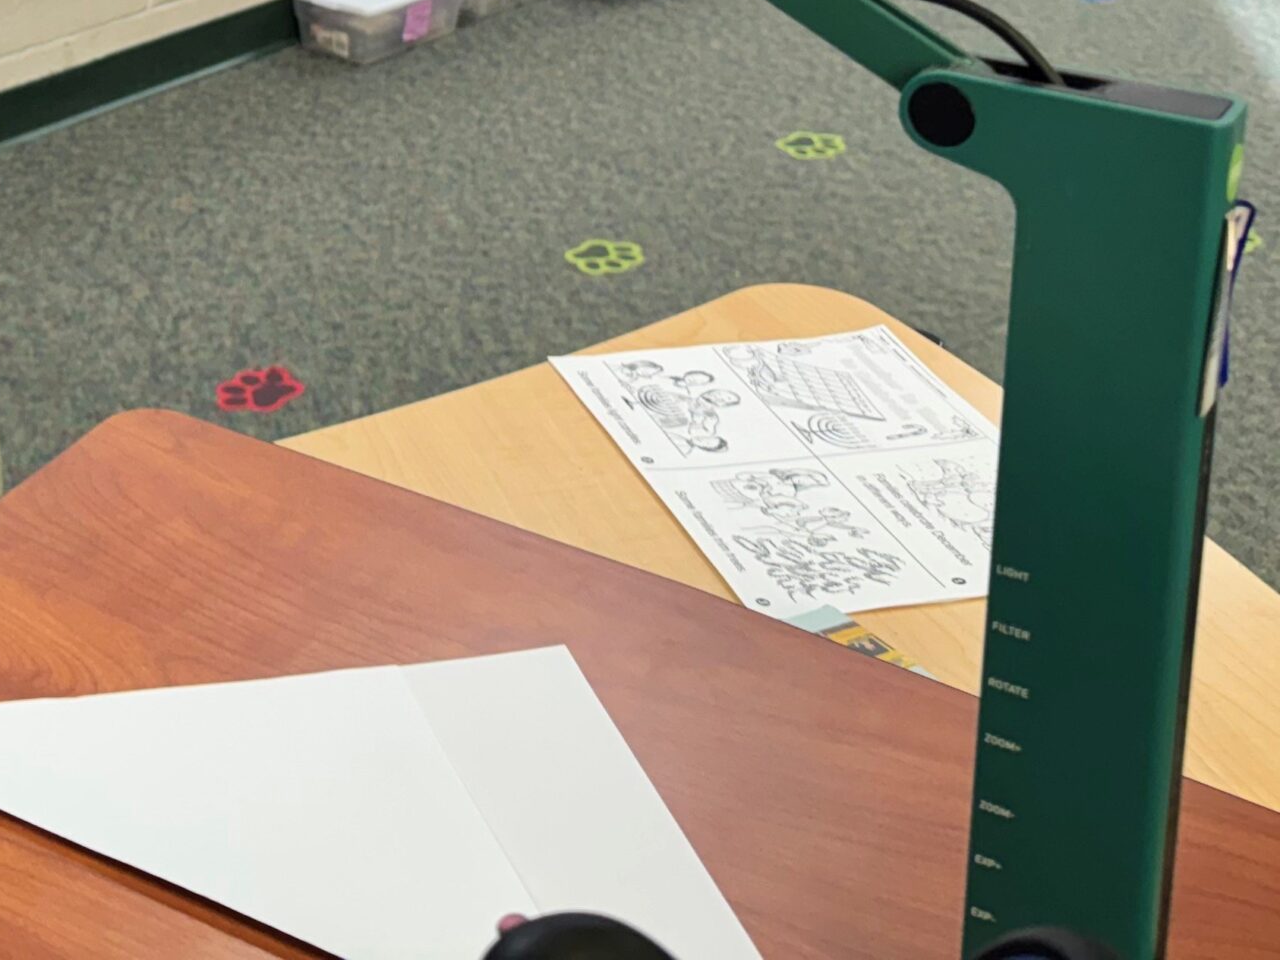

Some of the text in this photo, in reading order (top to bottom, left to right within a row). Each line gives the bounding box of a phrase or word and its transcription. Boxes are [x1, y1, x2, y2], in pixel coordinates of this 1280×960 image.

[995, 563, 1030, 582] LIGHT
[991, 620, 1031, 640] FILTER
[987, 676, 1029, 699] ROTATE
